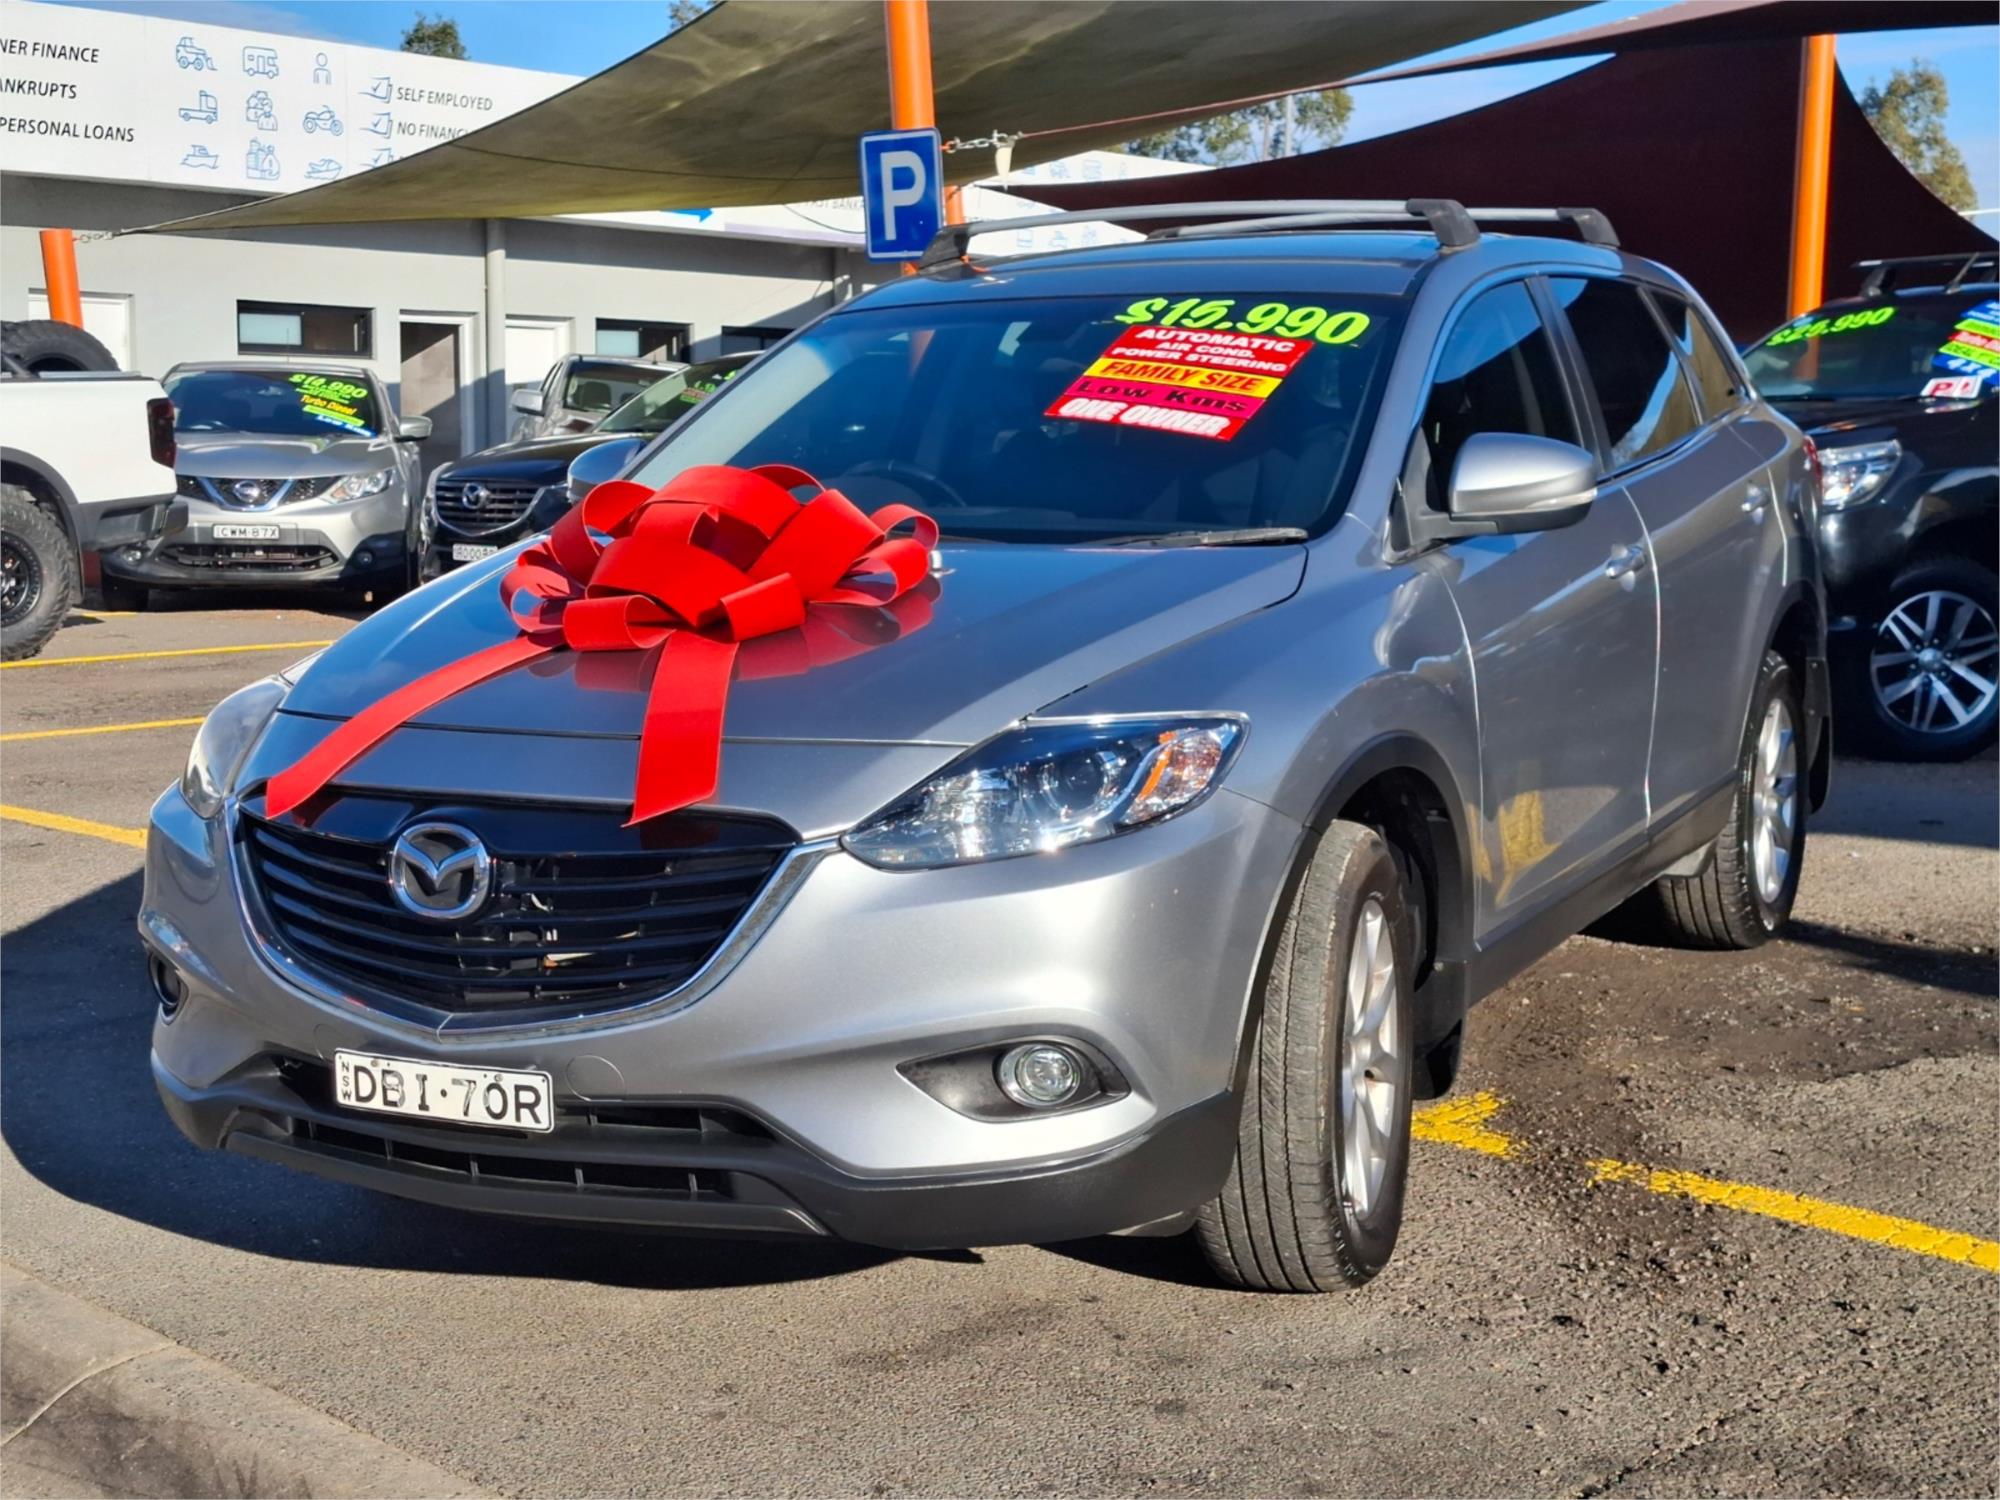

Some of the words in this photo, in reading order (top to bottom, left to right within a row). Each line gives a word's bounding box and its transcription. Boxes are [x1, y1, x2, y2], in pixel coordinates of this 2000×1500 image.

[32, 42, 100, 63] FINANCE
[0, 78, 78, 99] NKRUPTS
[396, 87, 425, 102] SELF
[427, 90, 494, 112] EMPLOYED
[0, 116, 80, 138] PERSONAL
[84, 124, 136, 142] LOANS
[396, 121, 417, 136] NO
[880, 150, 926, 241] P
[1134, 328, 1296, 352] AUTOMATIC
[1155, 341, 1193, 353] AIR
[1195, 344, 1256, 359] COND.
[1111, 346, 1184, 361] POWER
[1184, 353, 1288, 373] STEERING
[1101, 360, 1203, 382] FAMILY
[1199, 371, 1264, 392] SIZE
[1076, 380, 1150, 399] Low
[1165, 389, 1249, 412] Kms
[1058, 397, 1129, 421] ONE
[1118, 403, 1232, 438] OWNER
